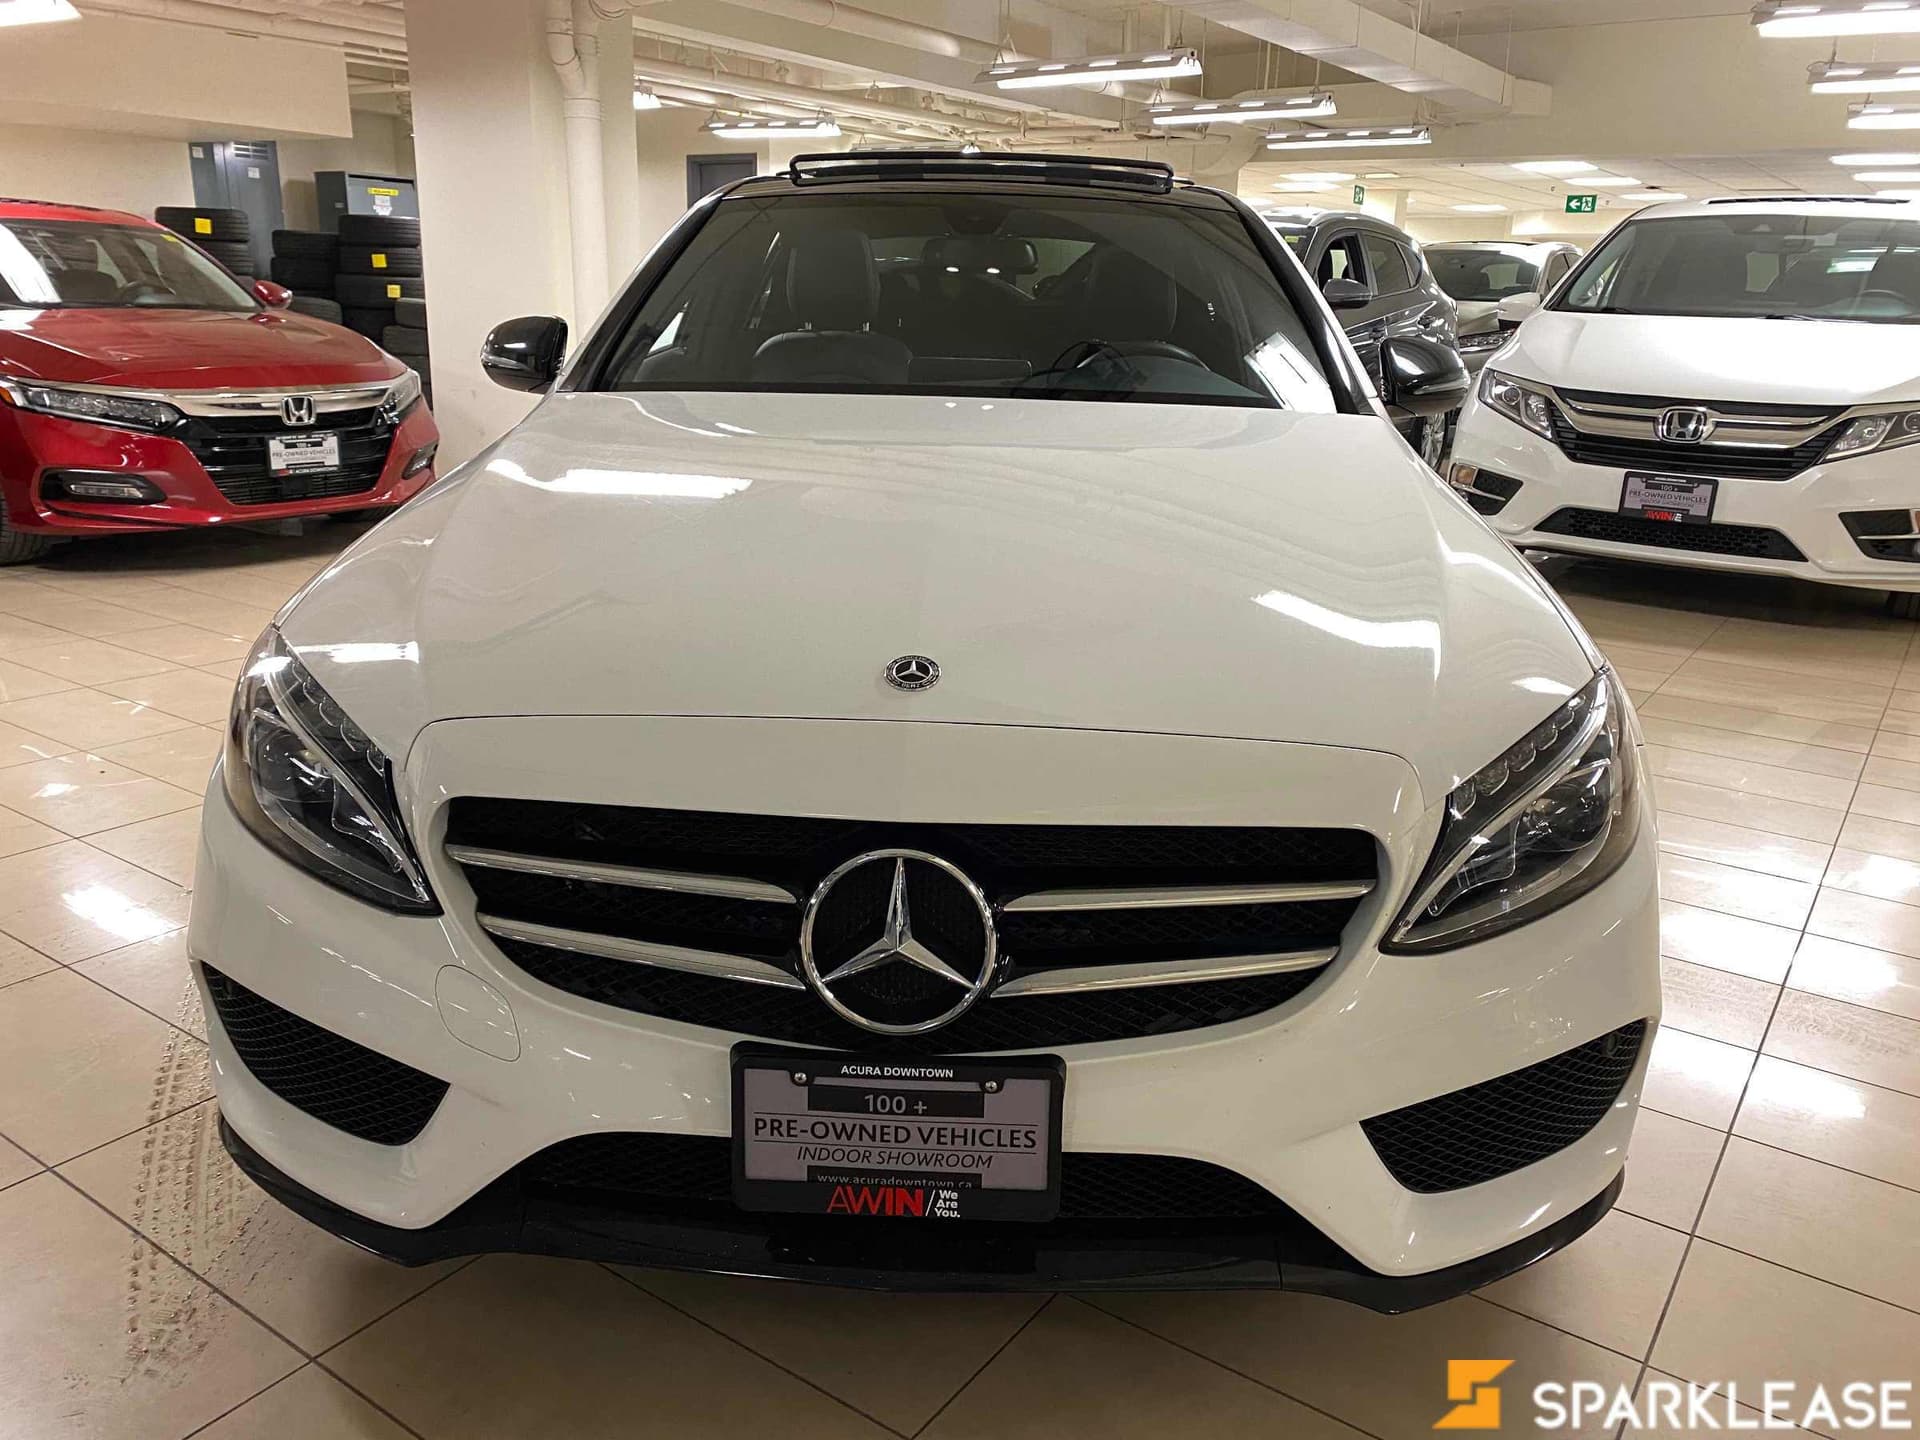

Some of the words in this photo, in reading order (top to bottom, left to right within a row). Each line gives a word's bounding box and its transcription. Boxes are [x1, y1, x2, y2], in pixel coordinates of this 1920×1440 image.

[841, 1065, 882, 1076] ACURA
[884, 1066, 954, 1078] DOWNTOWN
[864, 1094, 907, 1114] 100
[753, 1117, 911, 1144] PRE-OWNED
[917, 1125, 1037, 1149] VEHICLES
[796, 1145, 873, 1165] INDOOR
[876, 1149, 994, 1169] SHOWROOM
[817, 1174, 973, 1189] www.acuradowntownca
[826, 1185, 924, 1217] AWIN
[939, 1189, 958, 1200] We
[936, 1199, 958, 1209] Are
[934, 1208, 961, 1218] You.
